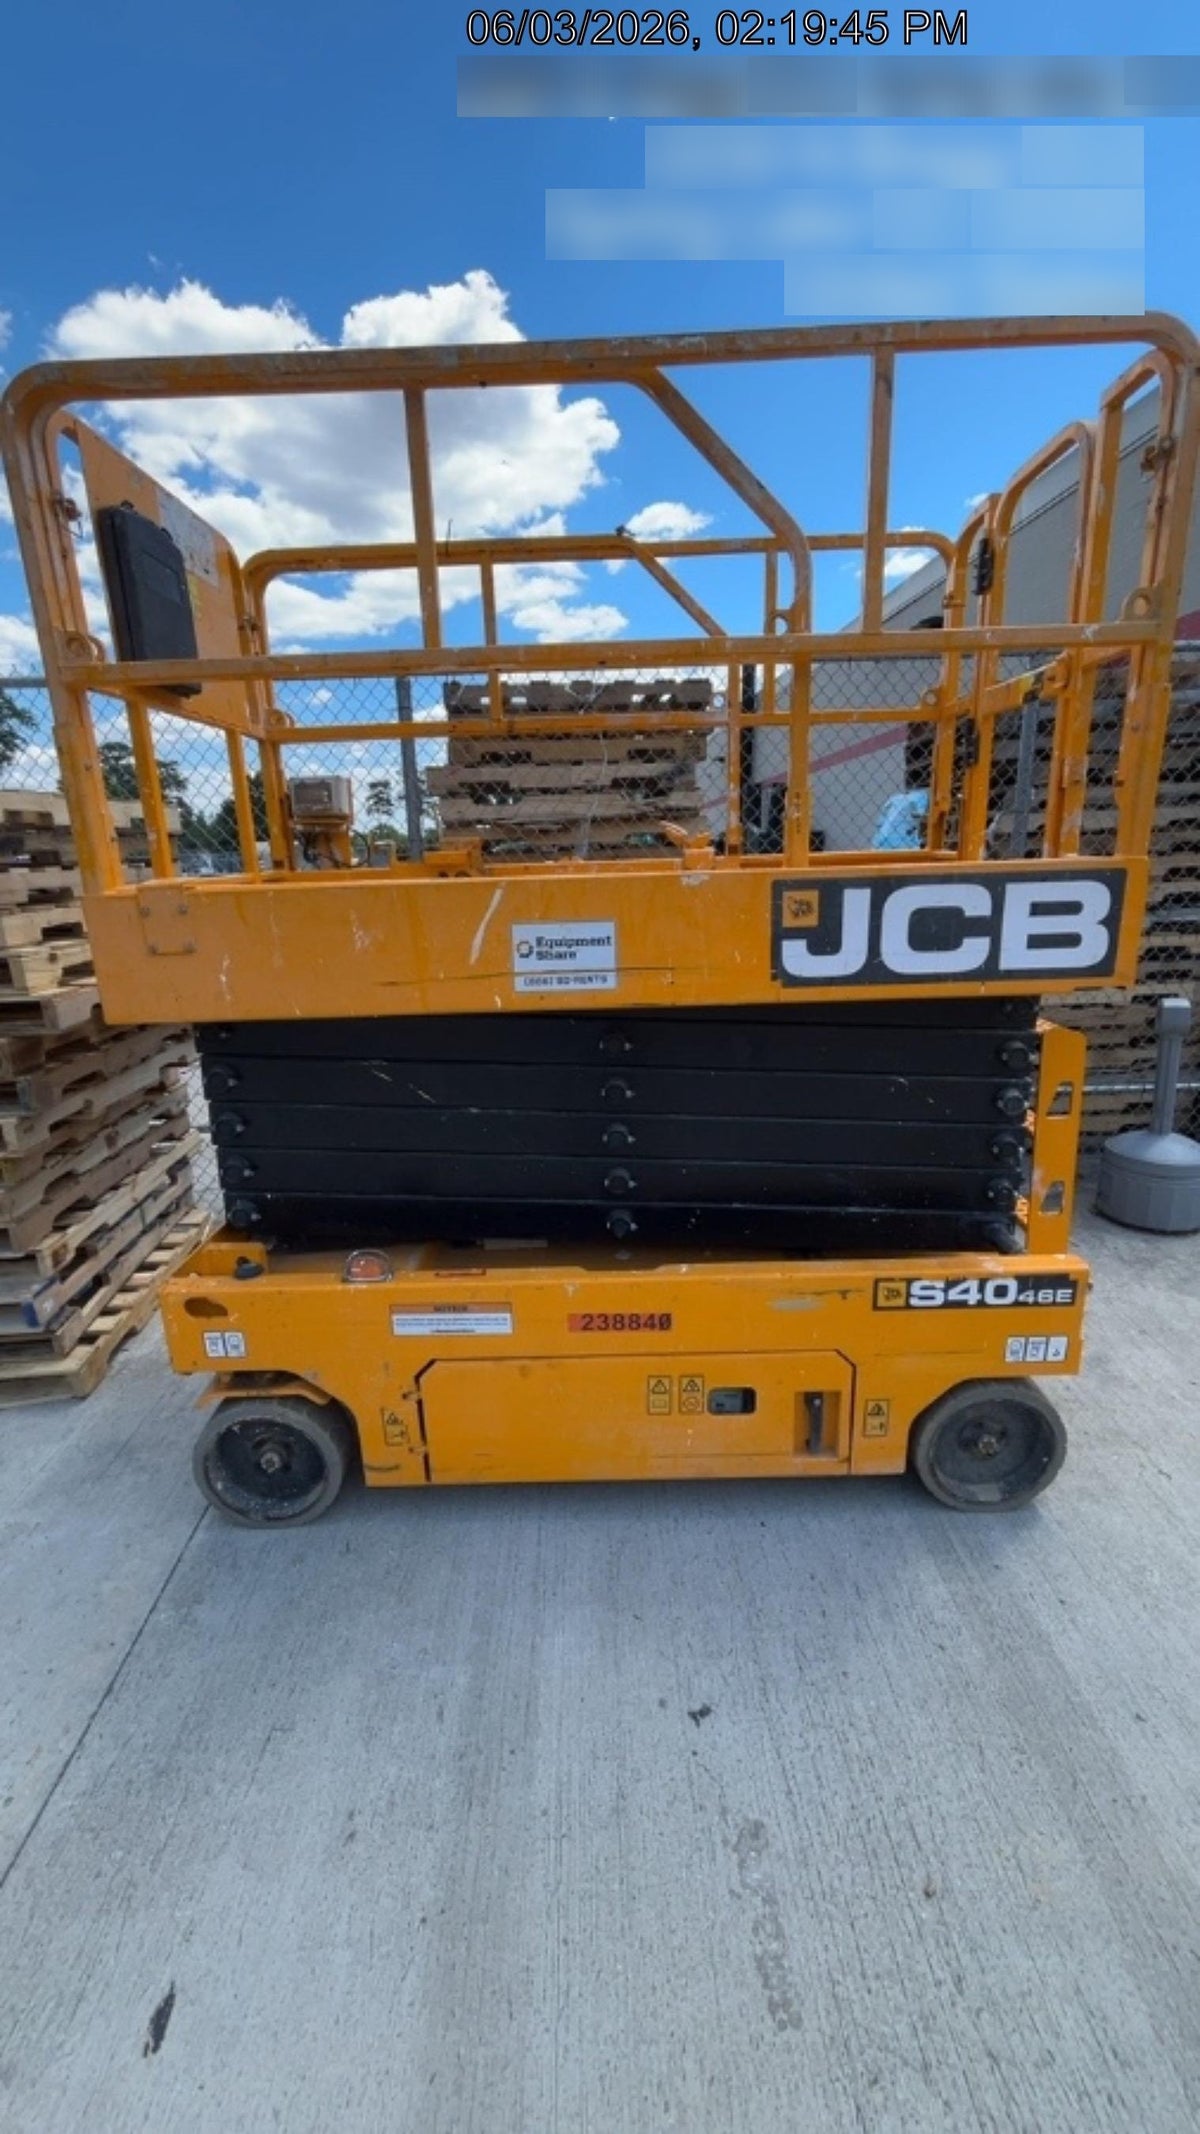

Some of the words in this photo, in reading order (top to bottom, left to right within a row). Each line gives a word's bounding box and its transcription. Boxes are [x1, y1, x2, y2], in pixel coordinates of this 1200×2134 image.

[782, 880, 1112, 978] JCB
[535, 936, 612, 950] Equipment
[535, 949, 577, 961] Share
[579, 1313, 673, 1332] 238840
